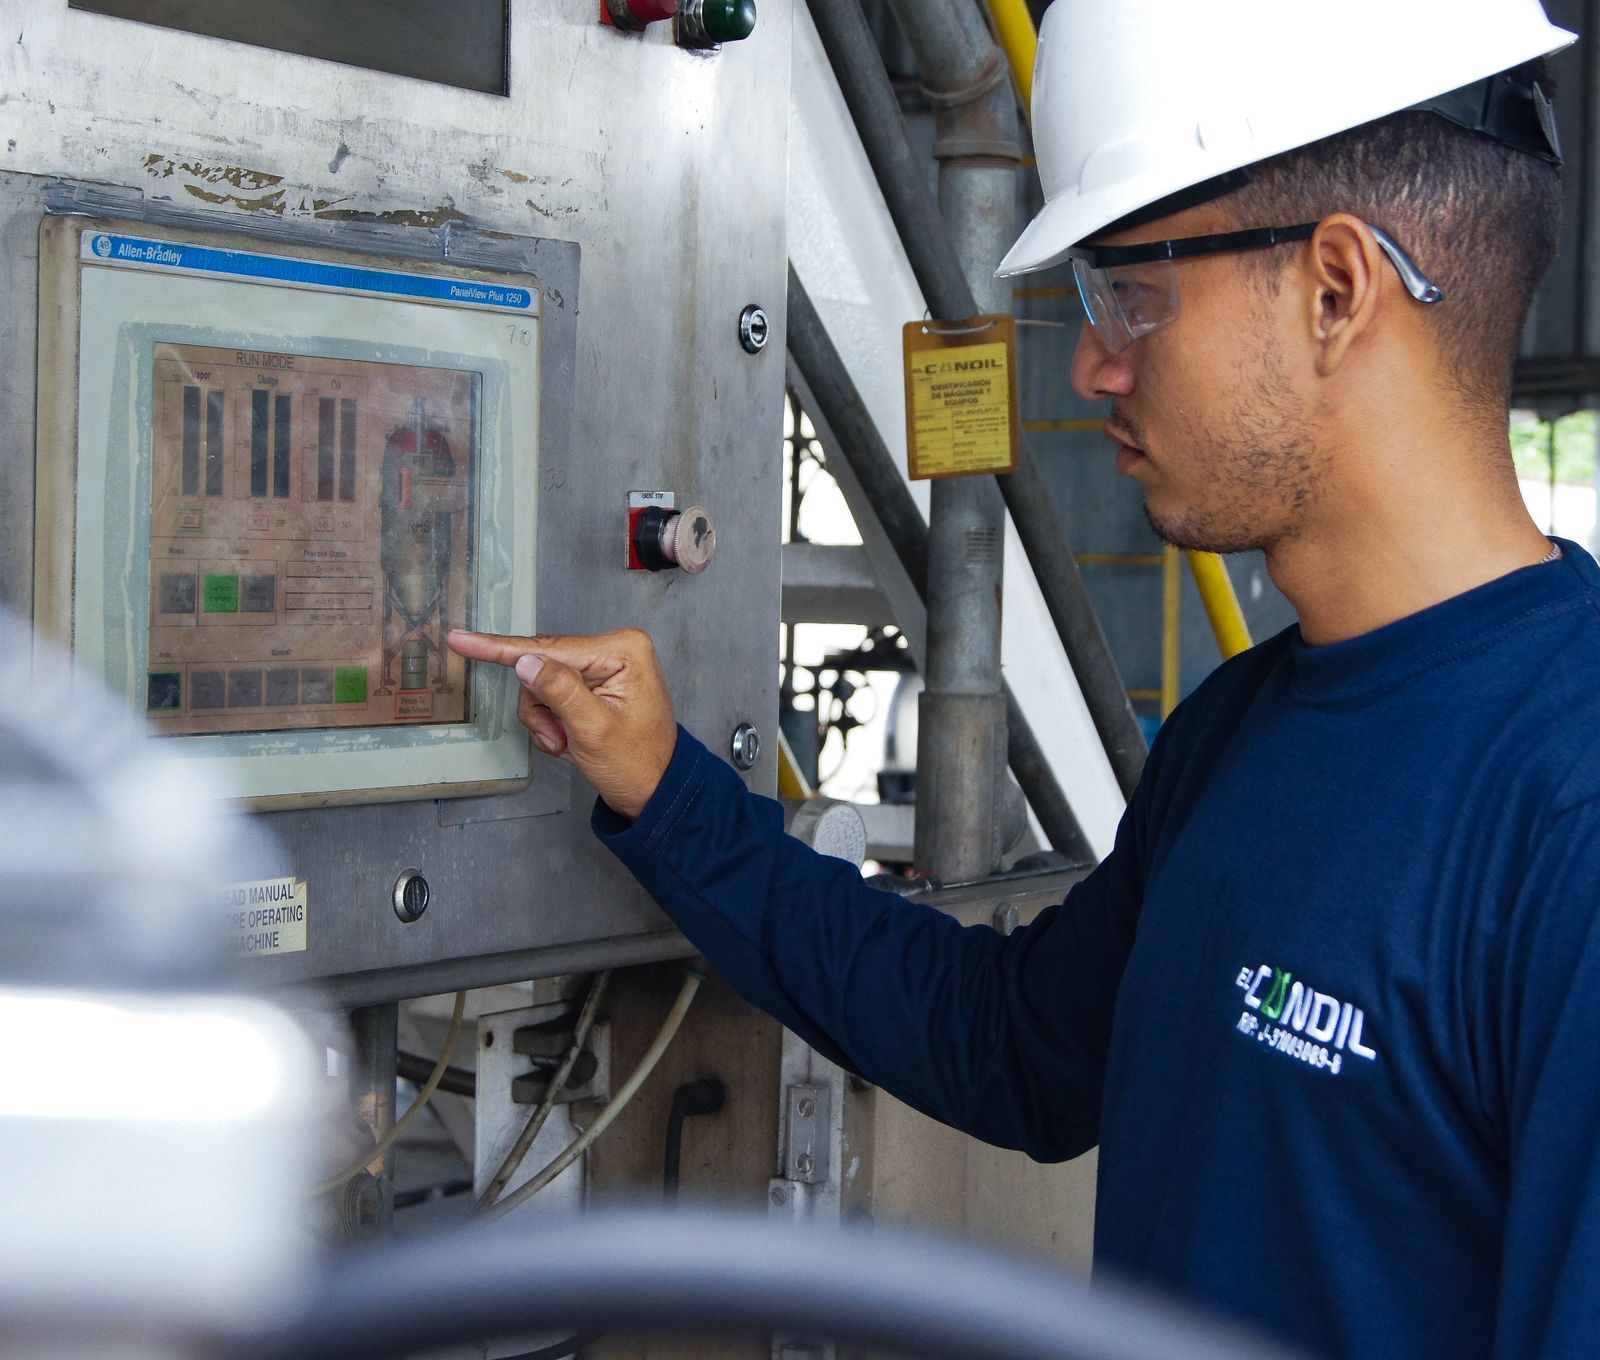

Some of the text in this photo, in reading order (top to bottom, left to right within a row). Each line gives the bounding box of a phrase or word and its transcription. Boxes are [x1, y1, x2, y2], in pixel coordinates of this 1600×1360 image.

[117, 243, 183, 265] Allen-Bradley
[450, 285, 522, 304] PanelView Plus 1250
[236, 352, 294, 369] RUN MODE
[190, 368, 211, 380] Vapor
[931, 390, 941, 400] DE
[944, 396, 979, 407] EQUIPOS
[249, 883, 294, 904] MANUAL
[248, 905, 303, 928] OPERATING
